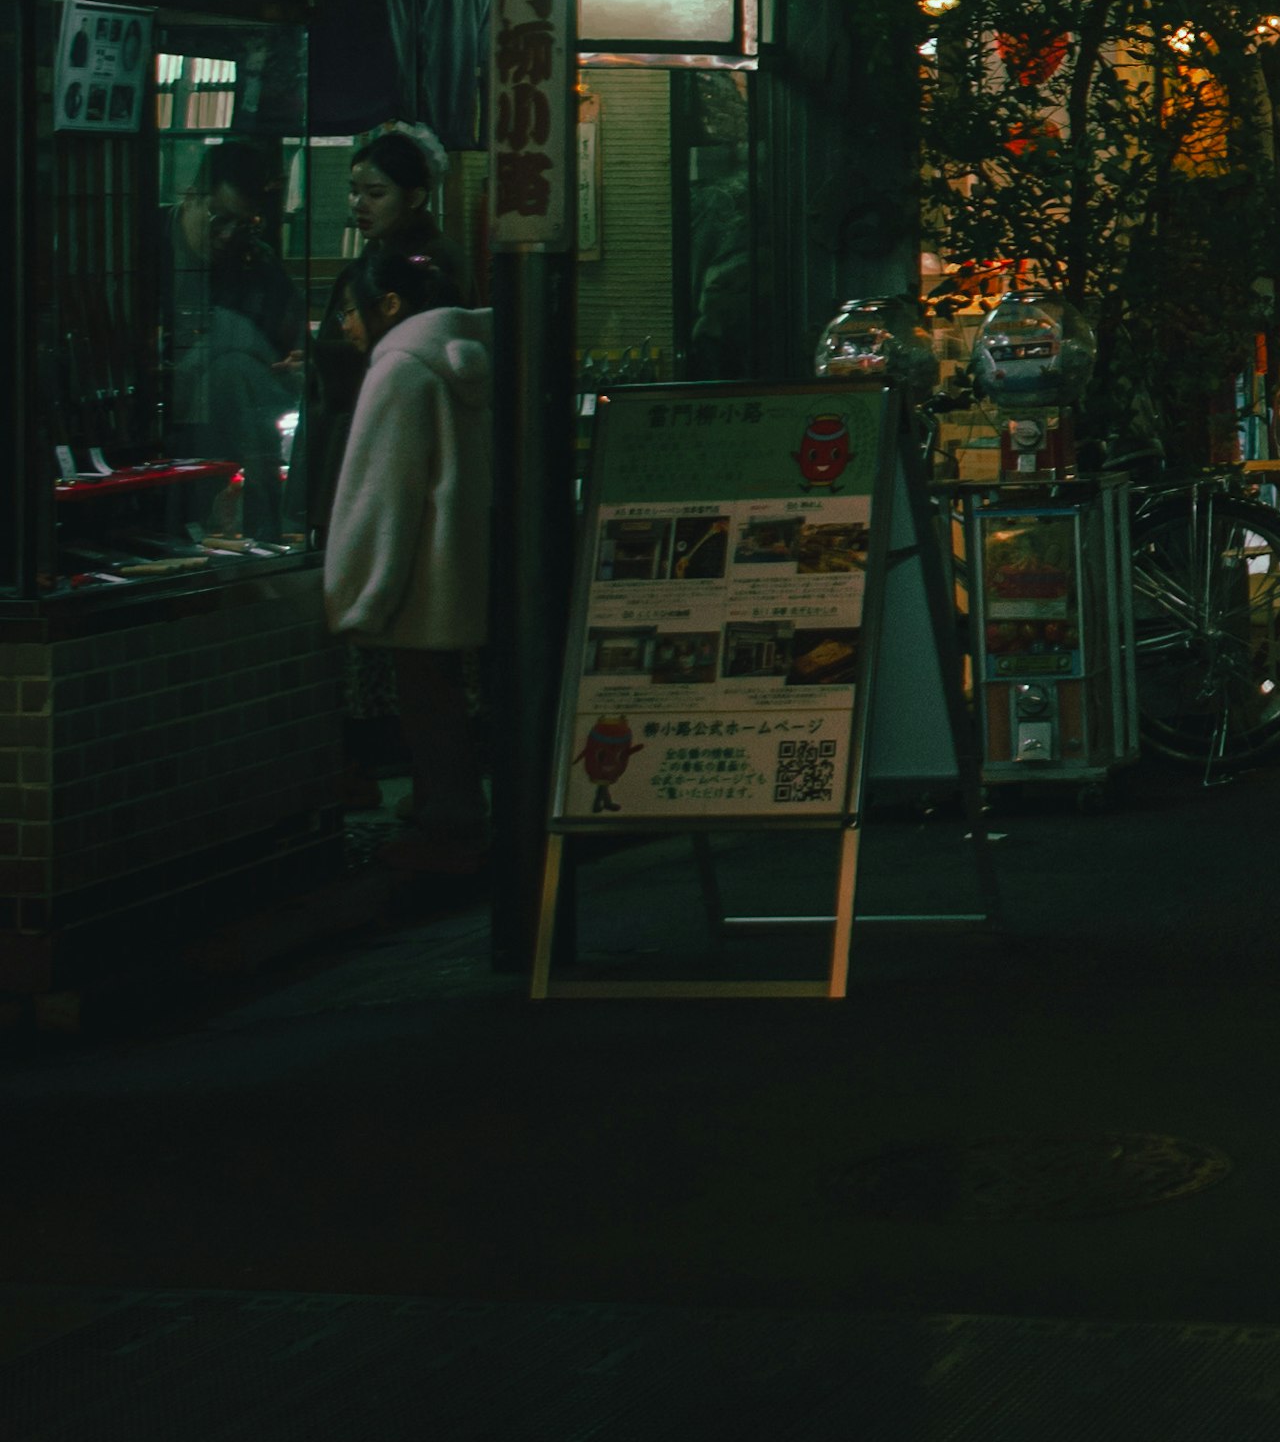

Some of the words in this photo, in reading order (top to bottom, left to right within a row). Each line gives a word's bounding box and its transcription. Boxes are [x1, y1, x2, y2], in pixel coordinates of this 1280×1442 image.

[644, 718, 824, 737] 柳小路公式ホームページ
